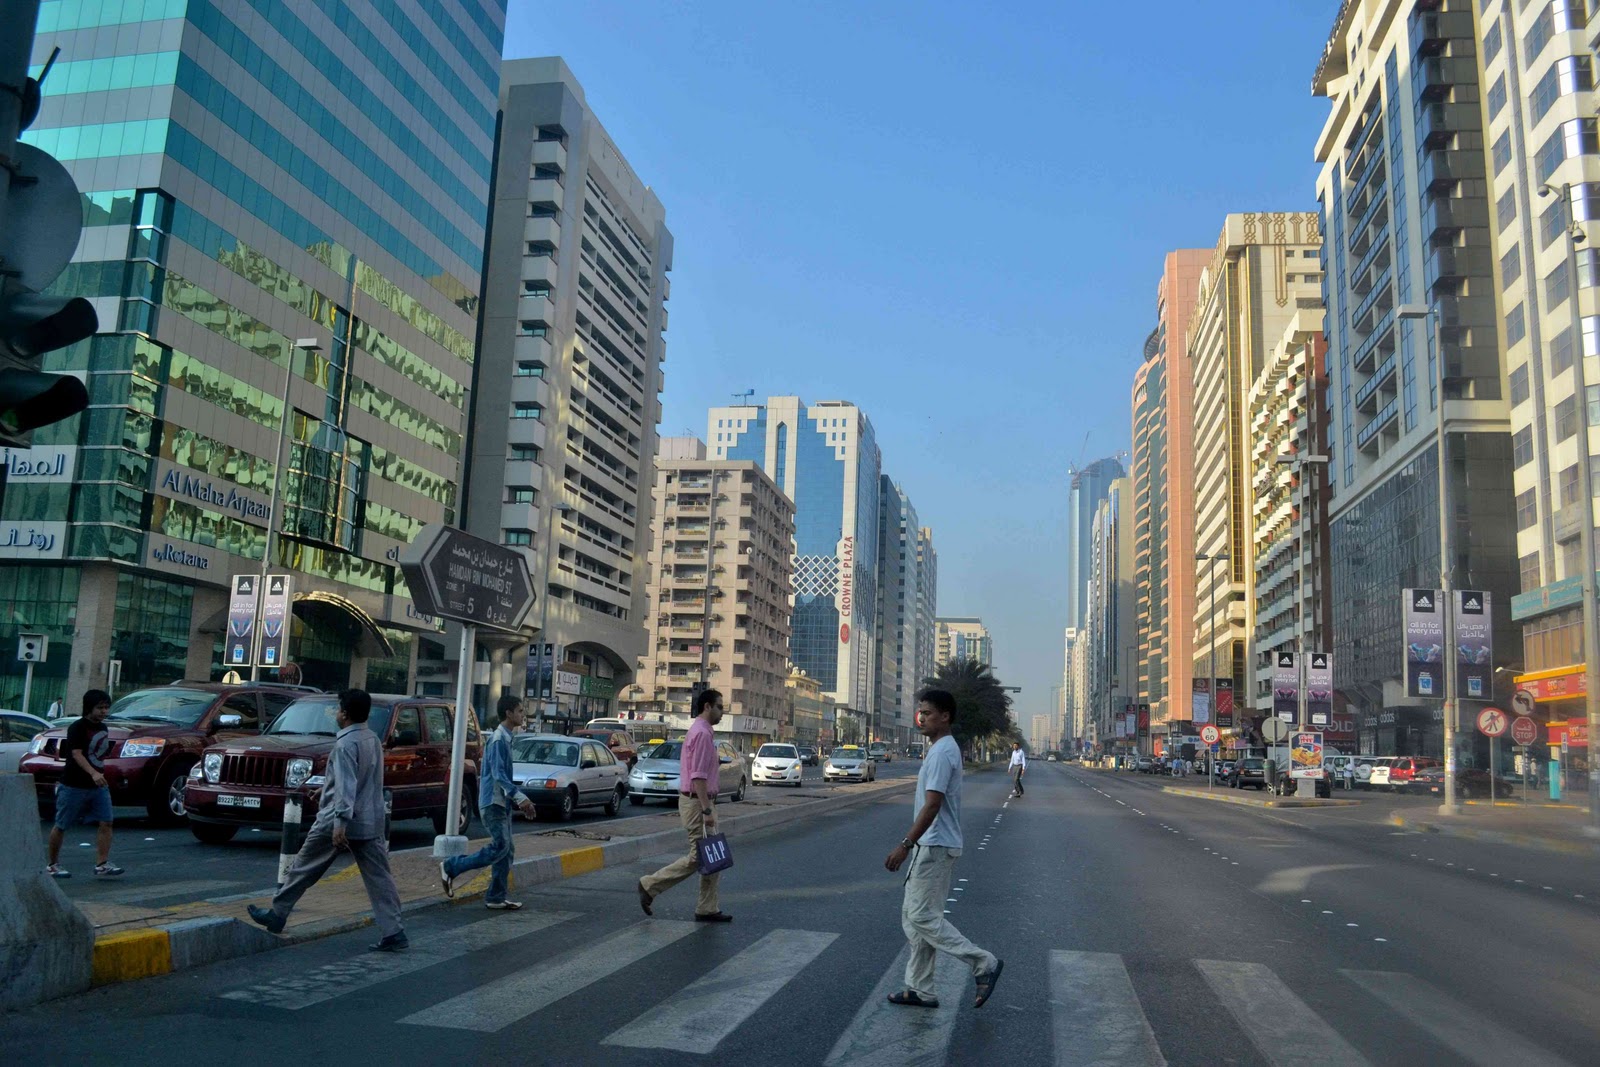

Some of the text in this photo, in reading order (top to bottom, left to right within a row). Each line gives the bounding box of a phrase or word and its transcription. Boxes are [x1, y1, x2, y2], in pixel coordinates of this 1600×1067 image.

[10, 453, 65, 476] المها
[162, 469, 181, 492] Al
[183, 475, 225, 507] Maha
[0, 528, 55, 551] روتان
[153, 543, 209, 569] by Rotana
[445, 581, 458, 592] ZONE
[449, 562, 472, 583] HAMDAN
[472, 569, 481, 586] BIN
[481, 573, 505, 593] MOHAMED
[841, 536, 853, 617] CROWNE PLAZA
[449, 597, 475, 614] STREET 5
[1407, 628, 1428, 636] every
[1428, 621, 1439, 629] for
[1515, 731, 1533, 739] STOP
[704, 840, 726, 864] GAP
